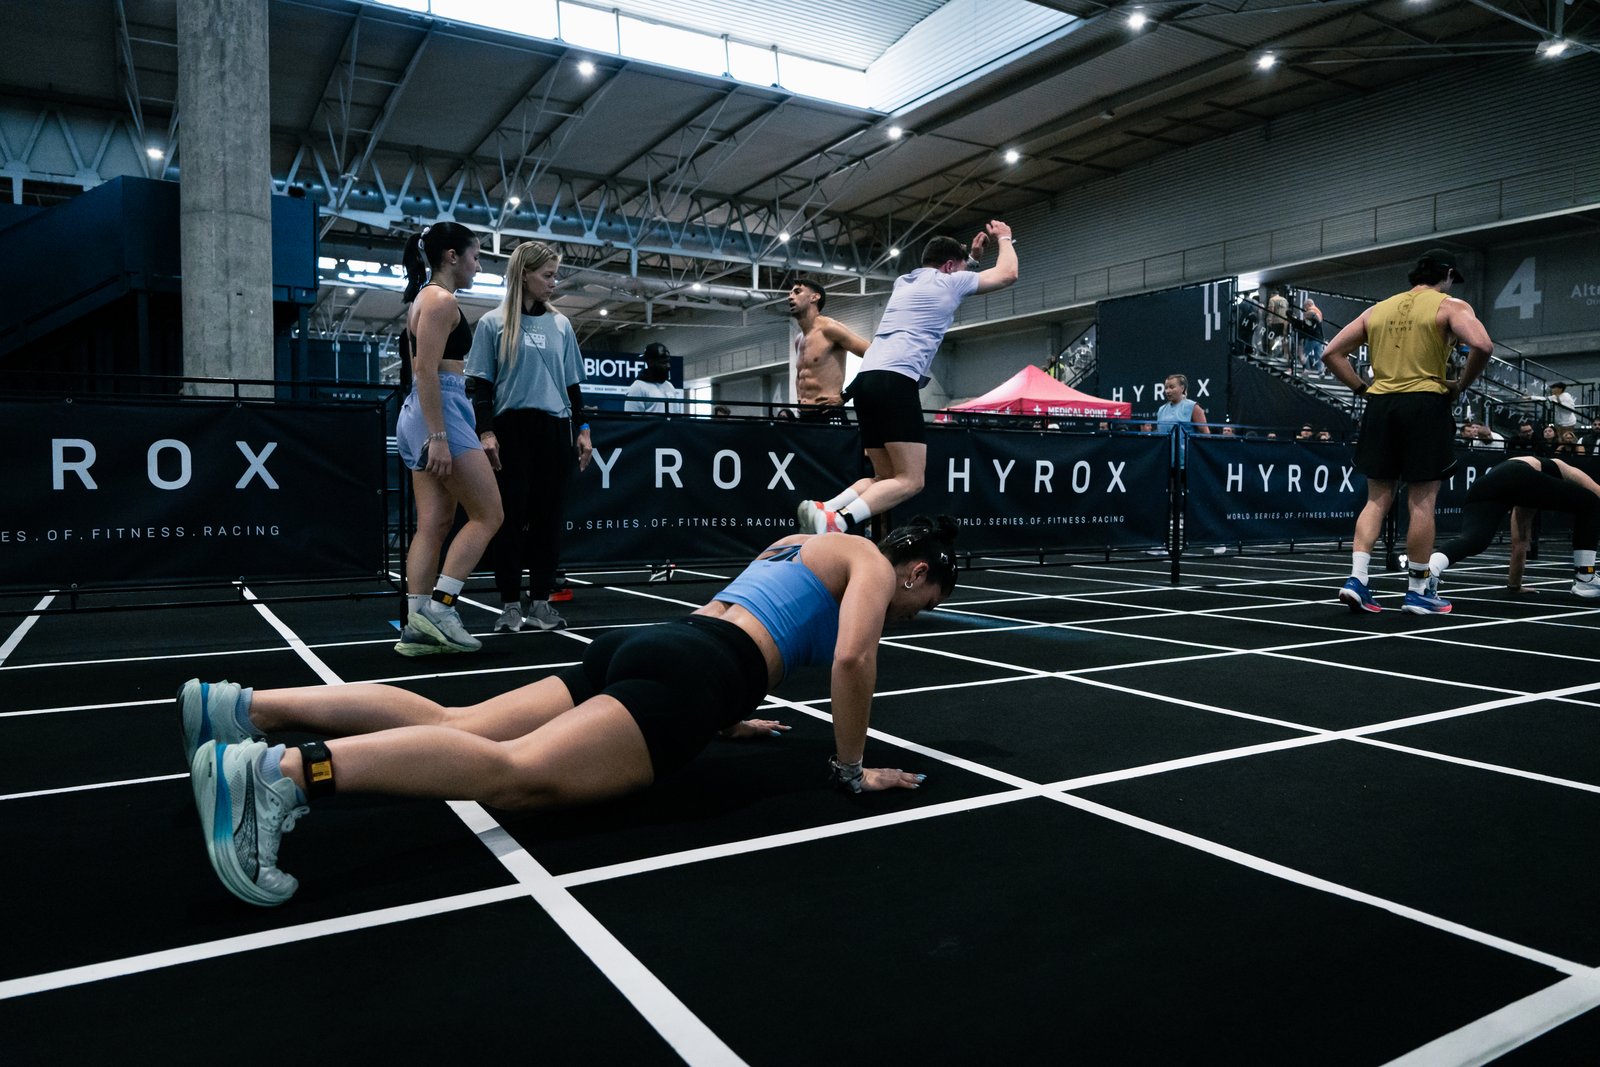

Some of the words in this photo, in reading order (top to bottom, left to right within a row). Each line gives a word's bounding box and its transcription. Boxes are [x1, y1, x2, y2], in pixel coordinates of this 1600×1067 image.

[1494, 256, 1541, 319] 4
[584, 358, 671, 380] BIOTHE
[1112, 378, 1210, 402] HYRX
[1048, 406, 1083, 417] MEDICAL
[1084, 408, 1108, 418] POINT
[948, 457, 1127, 493] HYROX
[1226, 463, 1355, 493] HYROX
